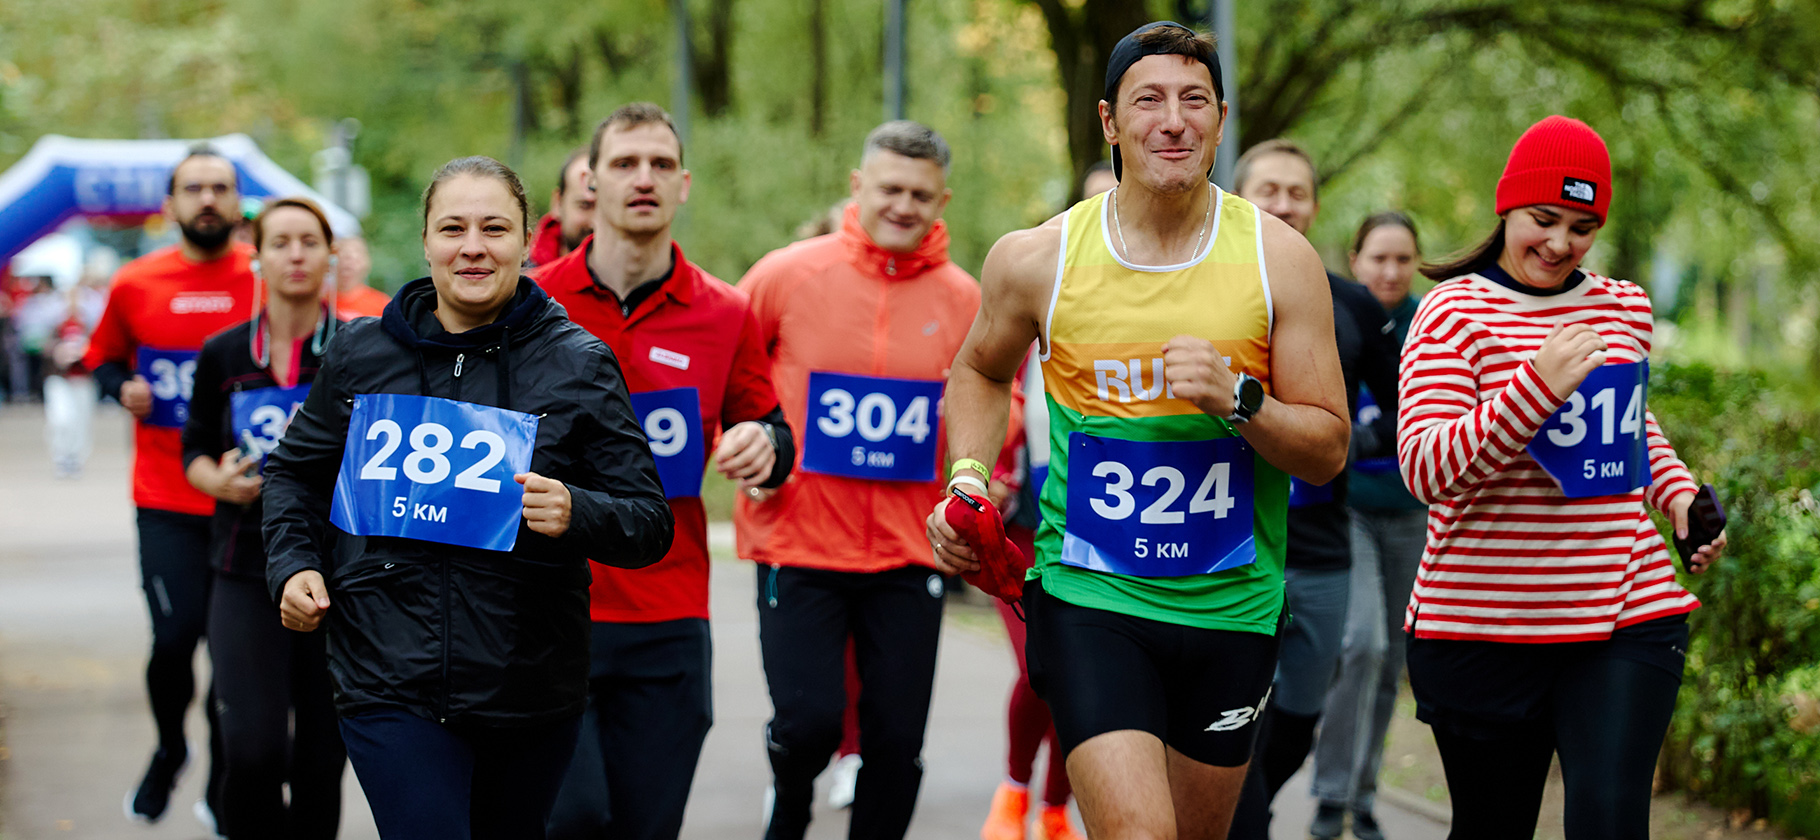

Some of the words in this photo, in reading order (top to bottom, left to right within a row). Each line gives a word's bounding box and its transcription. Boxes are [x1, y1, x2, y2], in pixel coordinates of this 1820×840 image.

[817, 388, 931, 443] 304
[1547, 384, 1643, 447] 314
[360, 419, 506, 493] 282
[851, 446, 866, 466] 5
[1583, 459, 1596, 479] 5
[392, 496, 407, 517] 5
[1089, 461, 1235, 524] 324
[1134, 538, 1148, 558] 5
